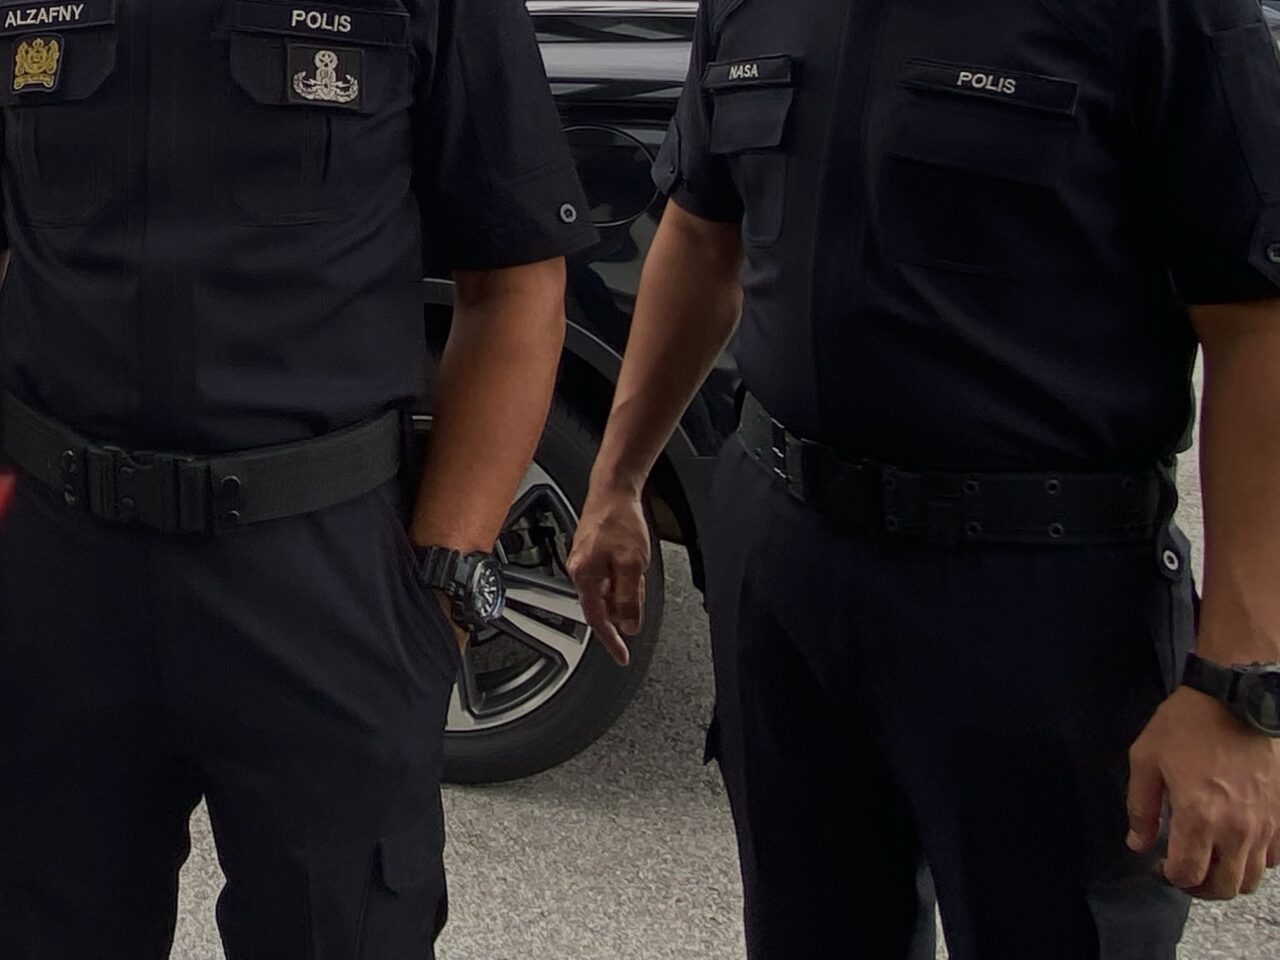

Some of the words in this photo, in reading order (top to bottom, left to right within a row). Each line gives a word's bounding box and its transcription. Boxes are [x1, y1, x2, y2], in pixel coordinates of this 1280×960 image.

[3, 3, 86, 29] ALZAFNY
[290, 8, 353, 33] POLIS
[727, 63, 759, 81] NASA
[956, 70, 1017, 95] POLIS
